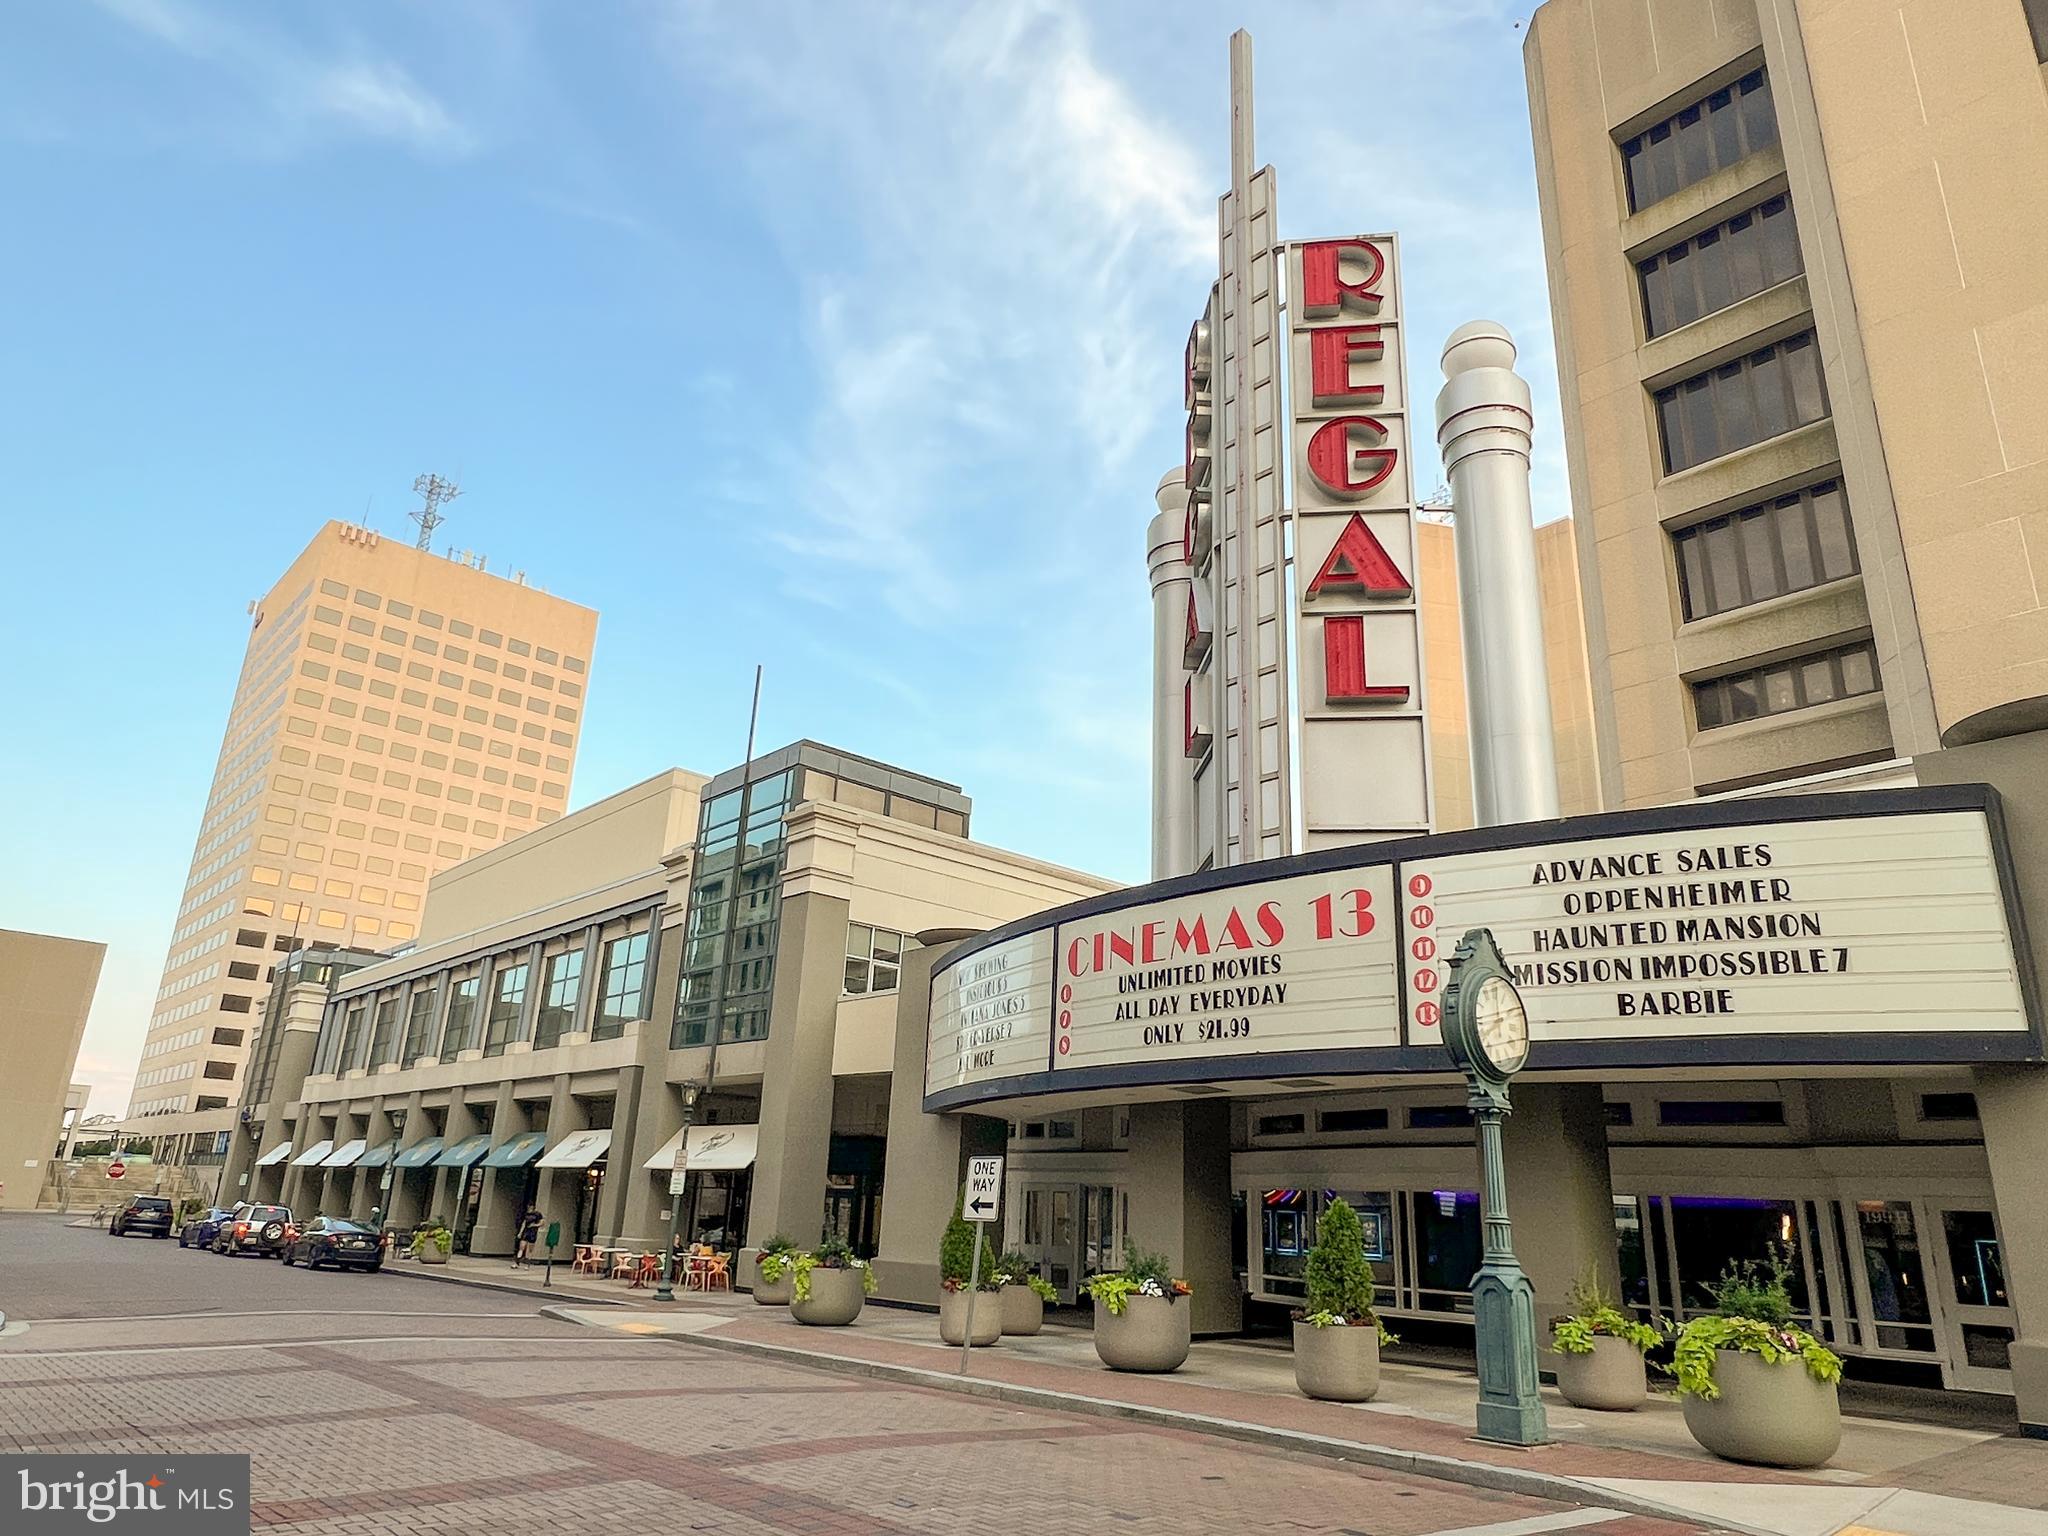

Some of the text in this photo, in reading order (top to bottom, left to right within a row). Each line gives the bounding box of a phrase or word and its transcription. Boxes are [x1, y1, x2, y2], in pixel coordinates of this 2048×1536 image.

[1303, 240, 1412, 704] REGAL
[1532, 844, 1772, 884] ADVANCE SALES
[1563, 878, 1792, 915] OPPENHEIMER
[1067, 889, 1375, 977] CINEMAS 13
[1533, 912, 1821, 952] HAUNTED MANSION
[1118, 953, 1282, 994] UNLIMITED MOVIES
[1514, 957, 1632, 986] MISSION
[1640, 949, 1828, 979] IMPOSSIBLE
[1115, 983, 1288, 1022] ALL DAY EVERYDAY
[1617, 989, 1734, 1016] BARBIE
[1143, 1016, 1250, 1045] ONLY $21.99
[973, 1178, 996, 1192] WAY
[974, 1161, 997, 1175] ONE
